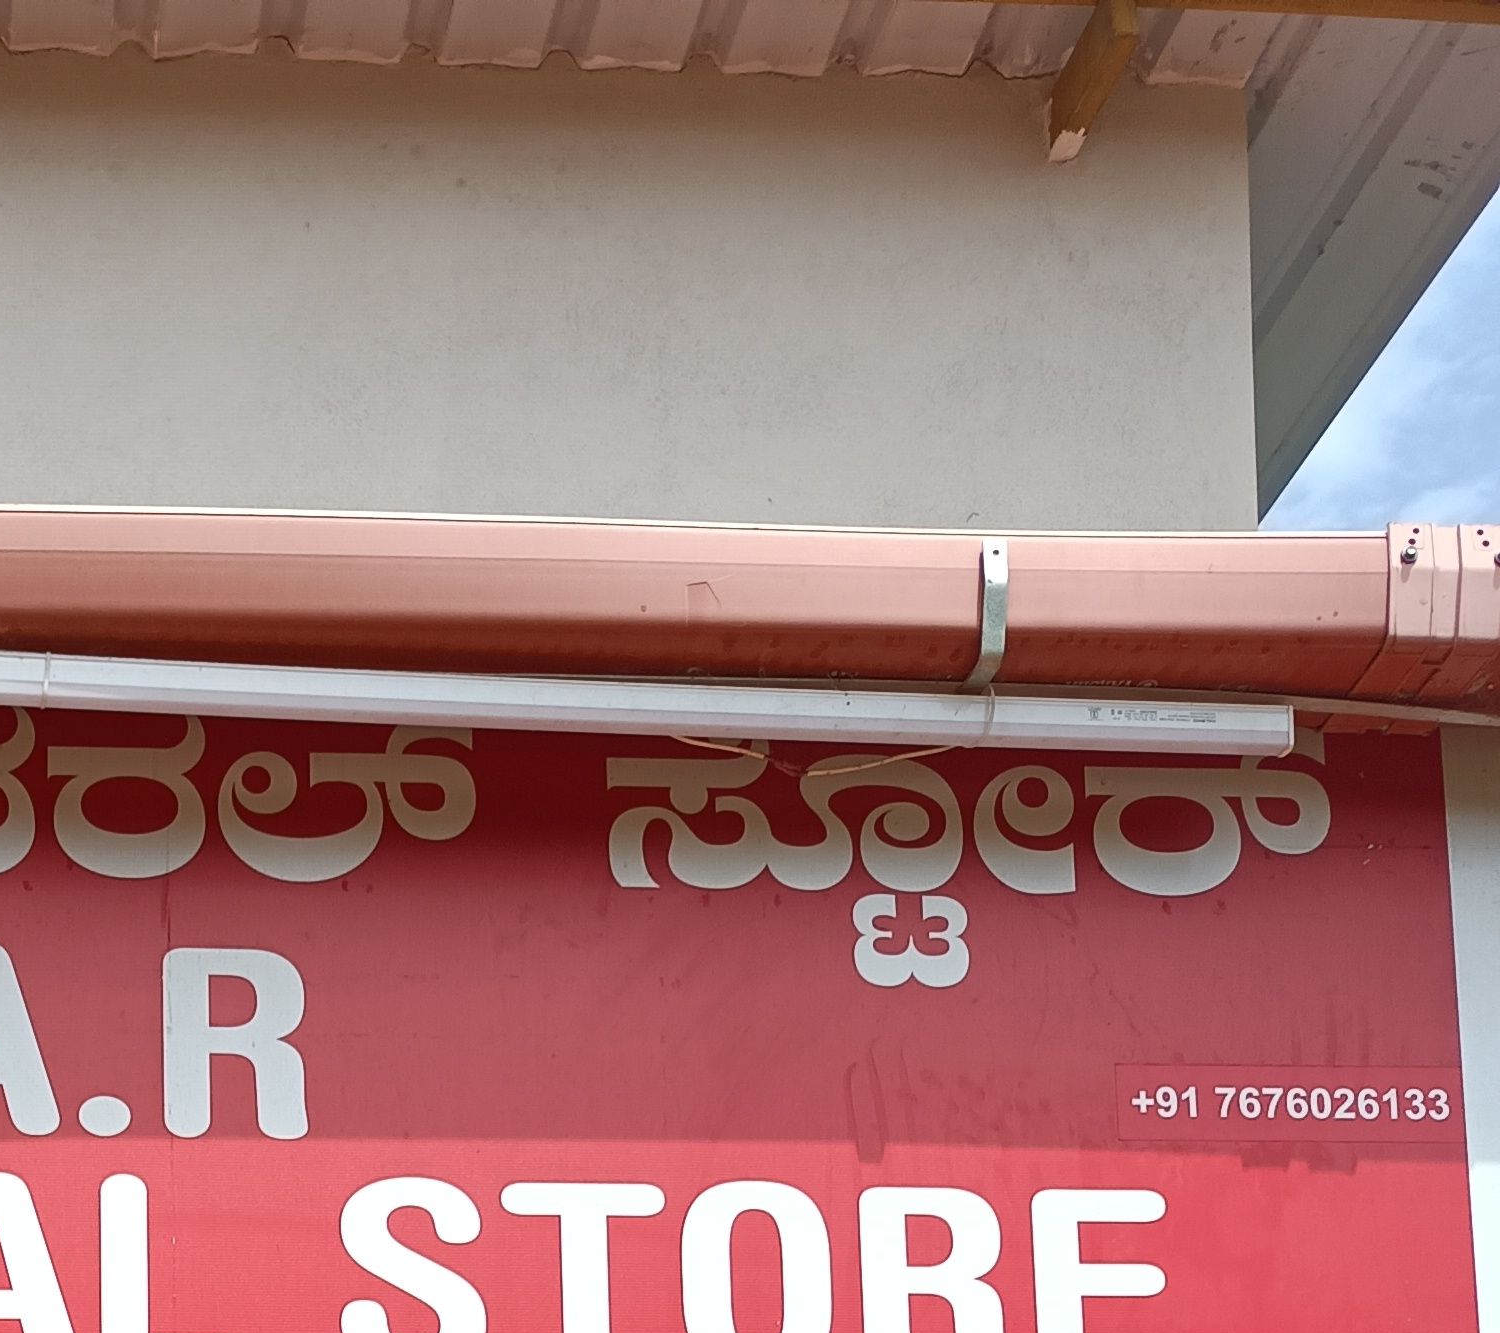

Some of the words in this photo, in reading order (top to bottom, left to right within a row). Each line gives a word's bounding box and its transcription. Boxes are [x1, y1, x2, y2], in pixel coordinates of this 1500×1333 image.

[605, 728, 1332, 989] ಸ್ಟೋರ್
[1131, 1085, 1198, 1118] +91
[1214, 1086, 1450, 1121] 7676026133
